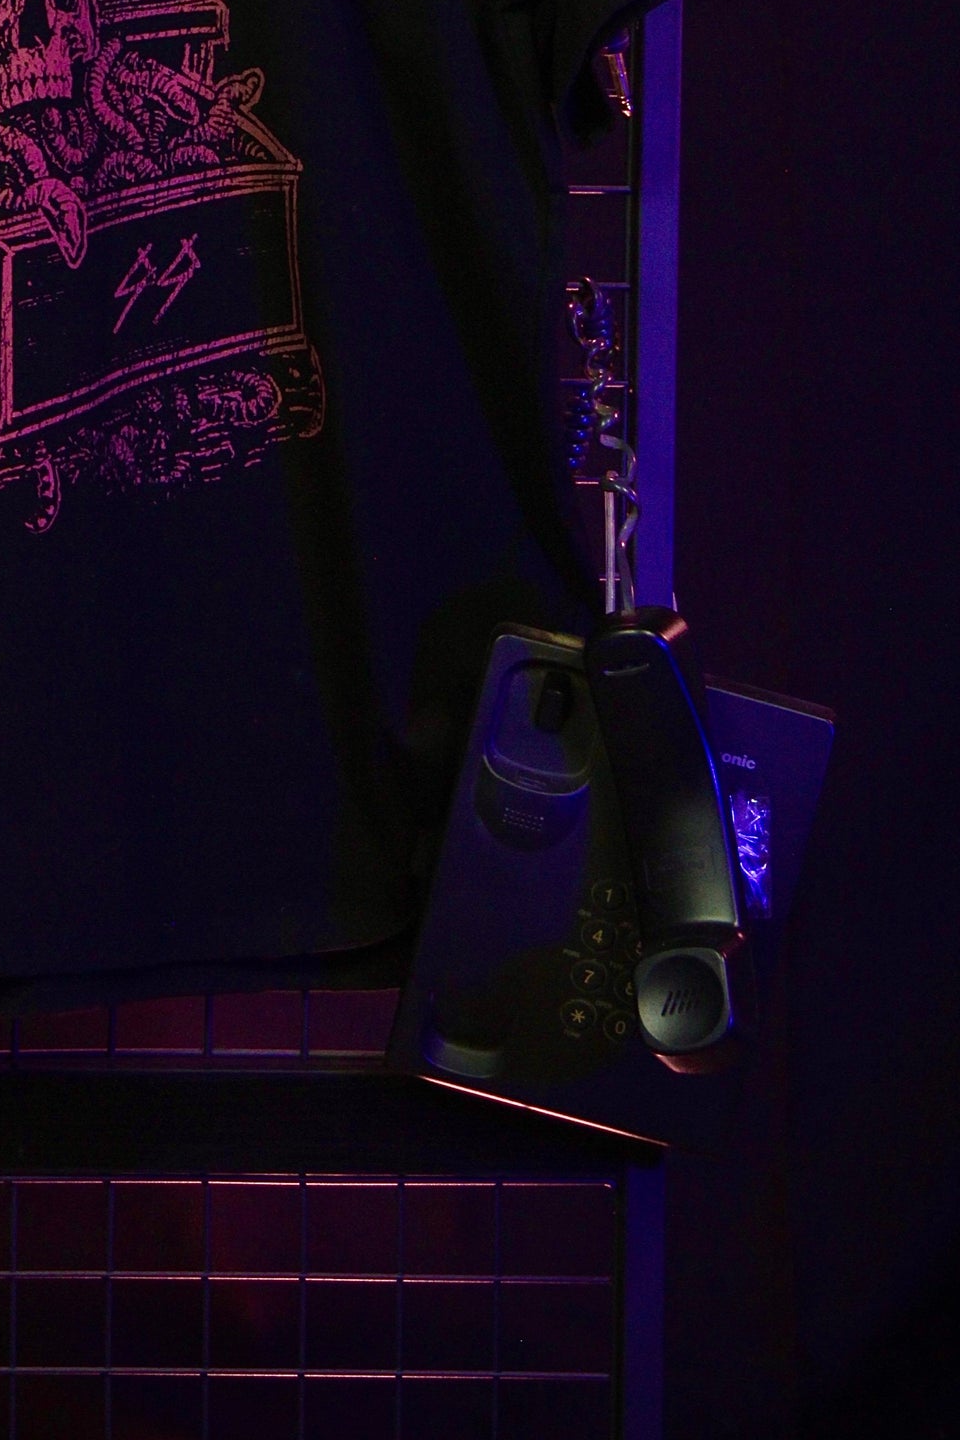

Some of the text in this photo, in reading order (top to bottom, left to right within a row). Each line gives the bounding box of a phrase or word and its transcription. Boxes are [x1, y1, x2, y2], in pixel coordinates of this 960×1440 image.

[721, 752, 756, 770] onic
[592, 929, 604, 943] 4
[584, 969, 595, 984] 7
